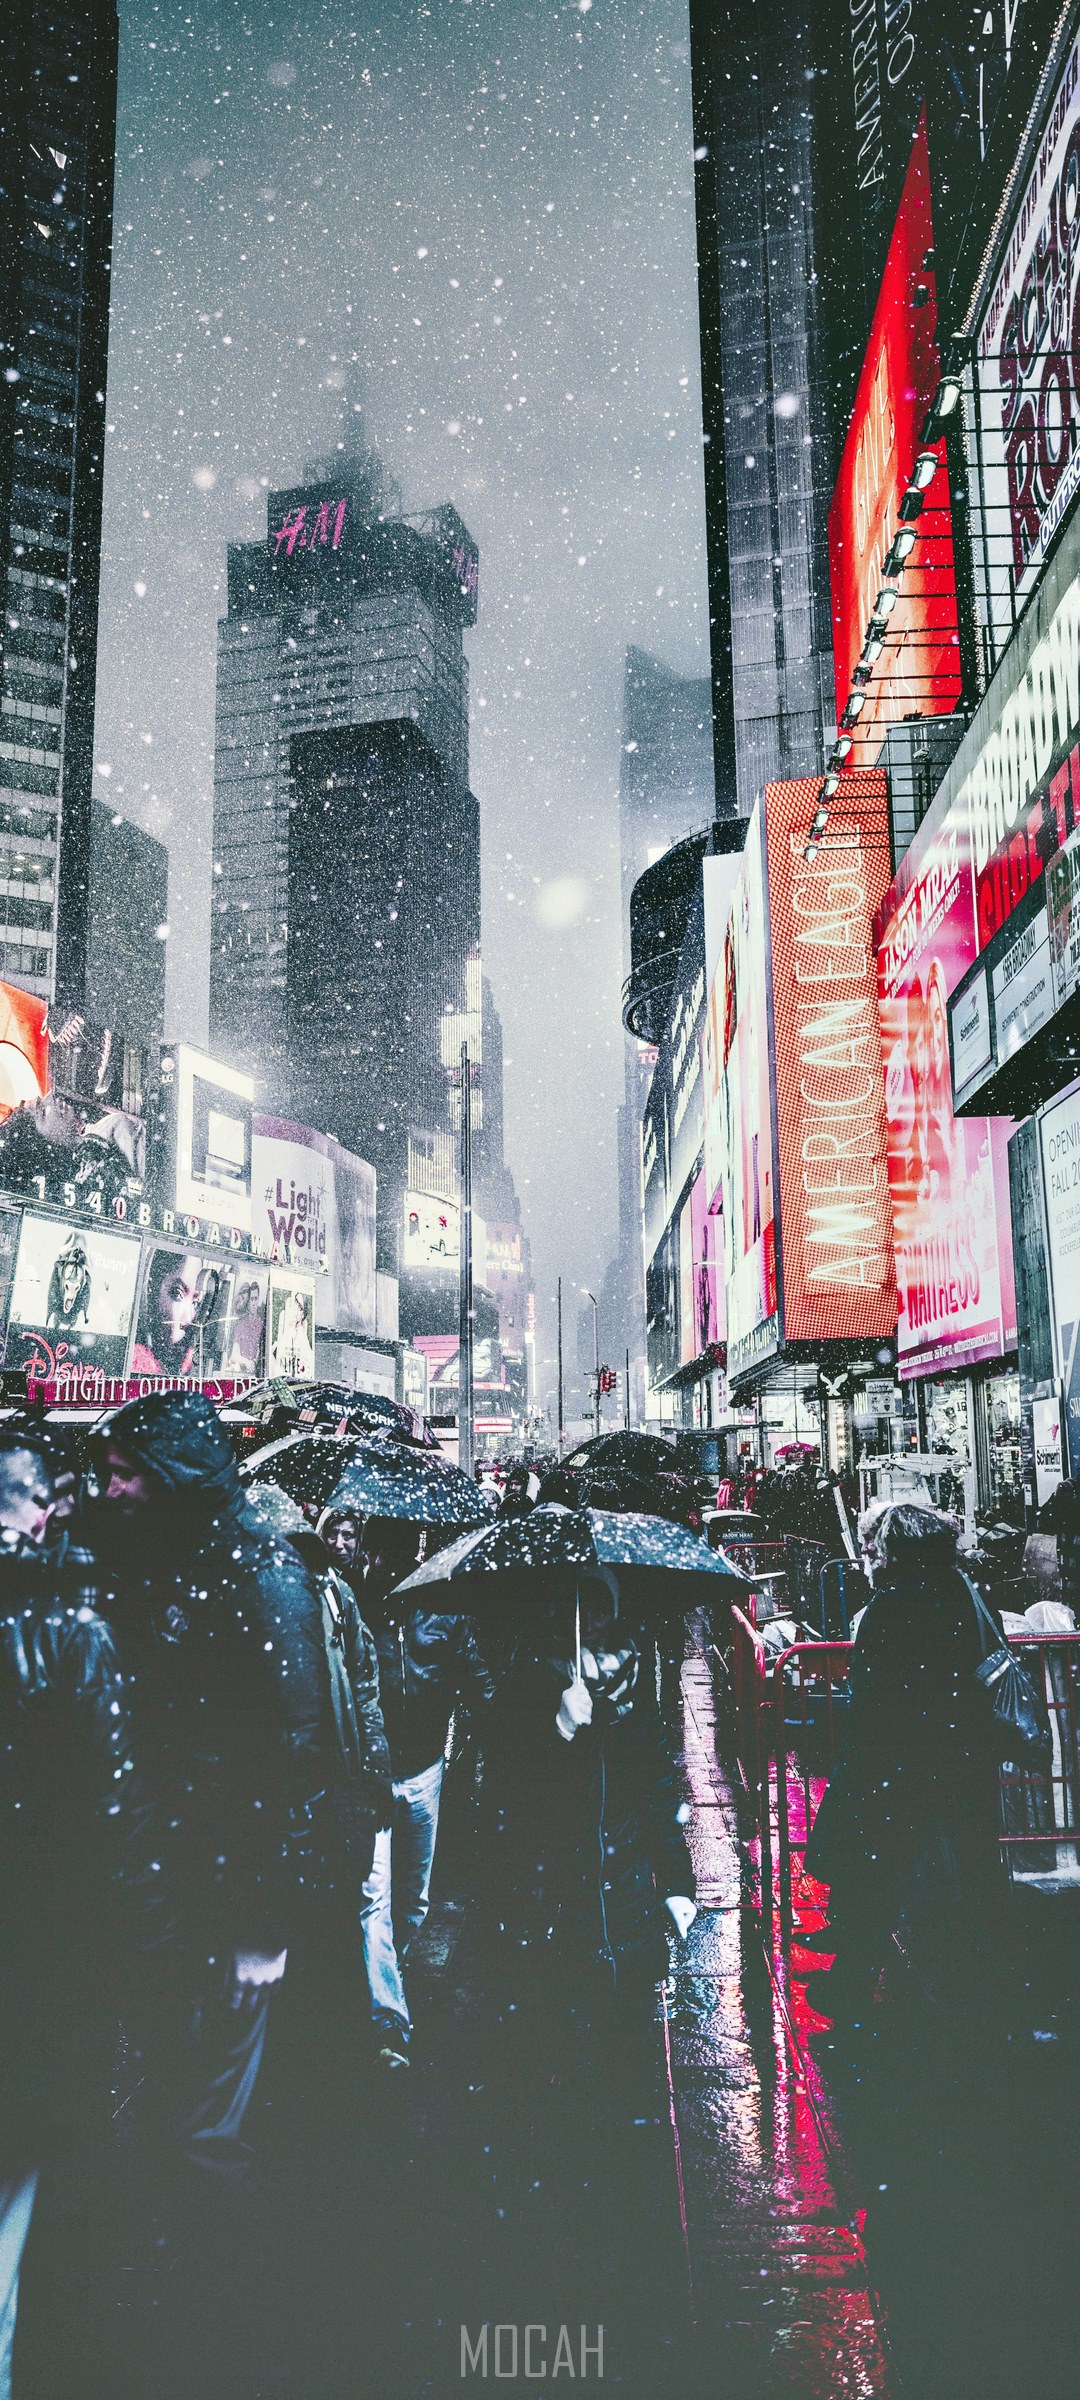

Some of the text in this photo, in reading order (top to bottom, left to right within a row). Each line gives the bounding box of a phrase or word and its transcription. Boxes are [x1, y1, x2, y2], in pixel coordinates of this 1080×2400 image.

[1012, 171, 1038, 273] LLOYD
[1039, 45, 1079, 188] WEBBER
[274, 498, 347, 556] H&M
[789, 824, 869, 982] EAGLE
[884, 901, 917, 990] JASON
[919, 829, 959, 930] MRAZ
[799, 1000, 881, 1289] AMERICAN
[1051, 1167, 1070, 1198] FALL
[32, 1176, 298, 1267] 1540 BROADWAY
[267, 1209, 326, 1255] World
[903, 1205, 980, 1331] WAITRESS
[55, 1378, 132, 1402] MIGHTY
[325, 1402, 397, 1428] NEW YORK
[1037, 1447, 1060, 1466] Schimenti
